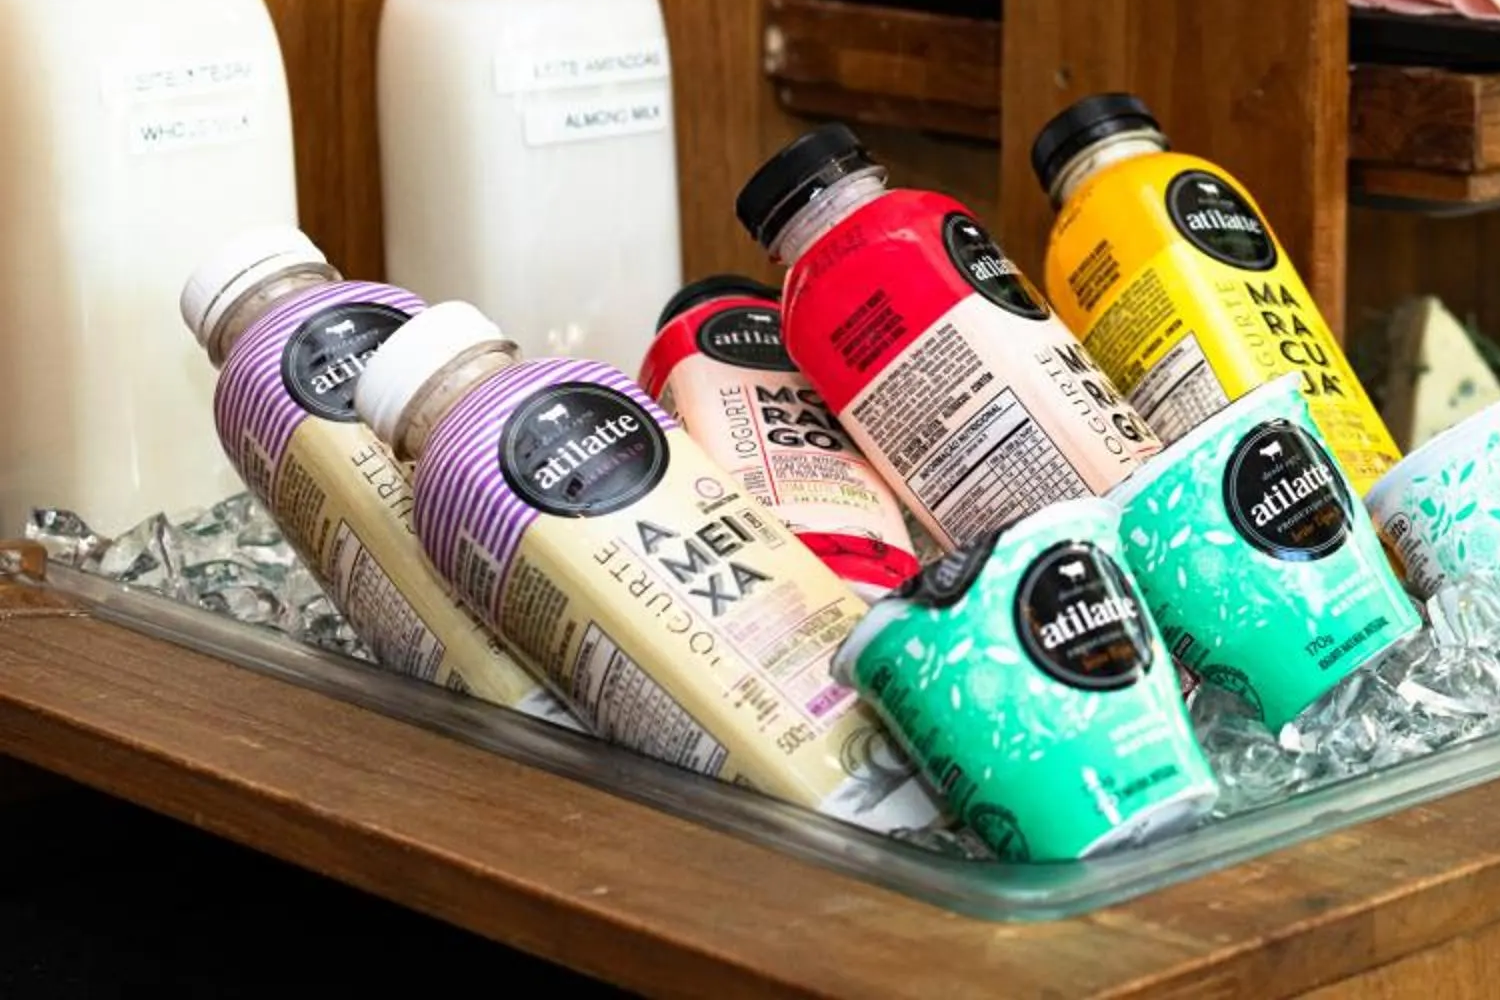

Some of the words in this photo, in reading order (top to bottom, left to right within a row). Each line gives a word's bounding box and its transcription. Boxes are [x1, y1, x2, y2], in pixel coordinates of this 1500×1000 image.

[1244, 281, 1301, 308] MA
[1261, 311, 1313, 337] RA
[1280, 340, 1329, 367] CU
[534, 413, 640, 490] atilatte
[767, 427, 844, 452] GO
[1251, 463, 1333, 527] atilatte
[636, 519, 678, 556] A
[658, 515, 755, 585] MEI
[687, 561, 774, 617] XA
